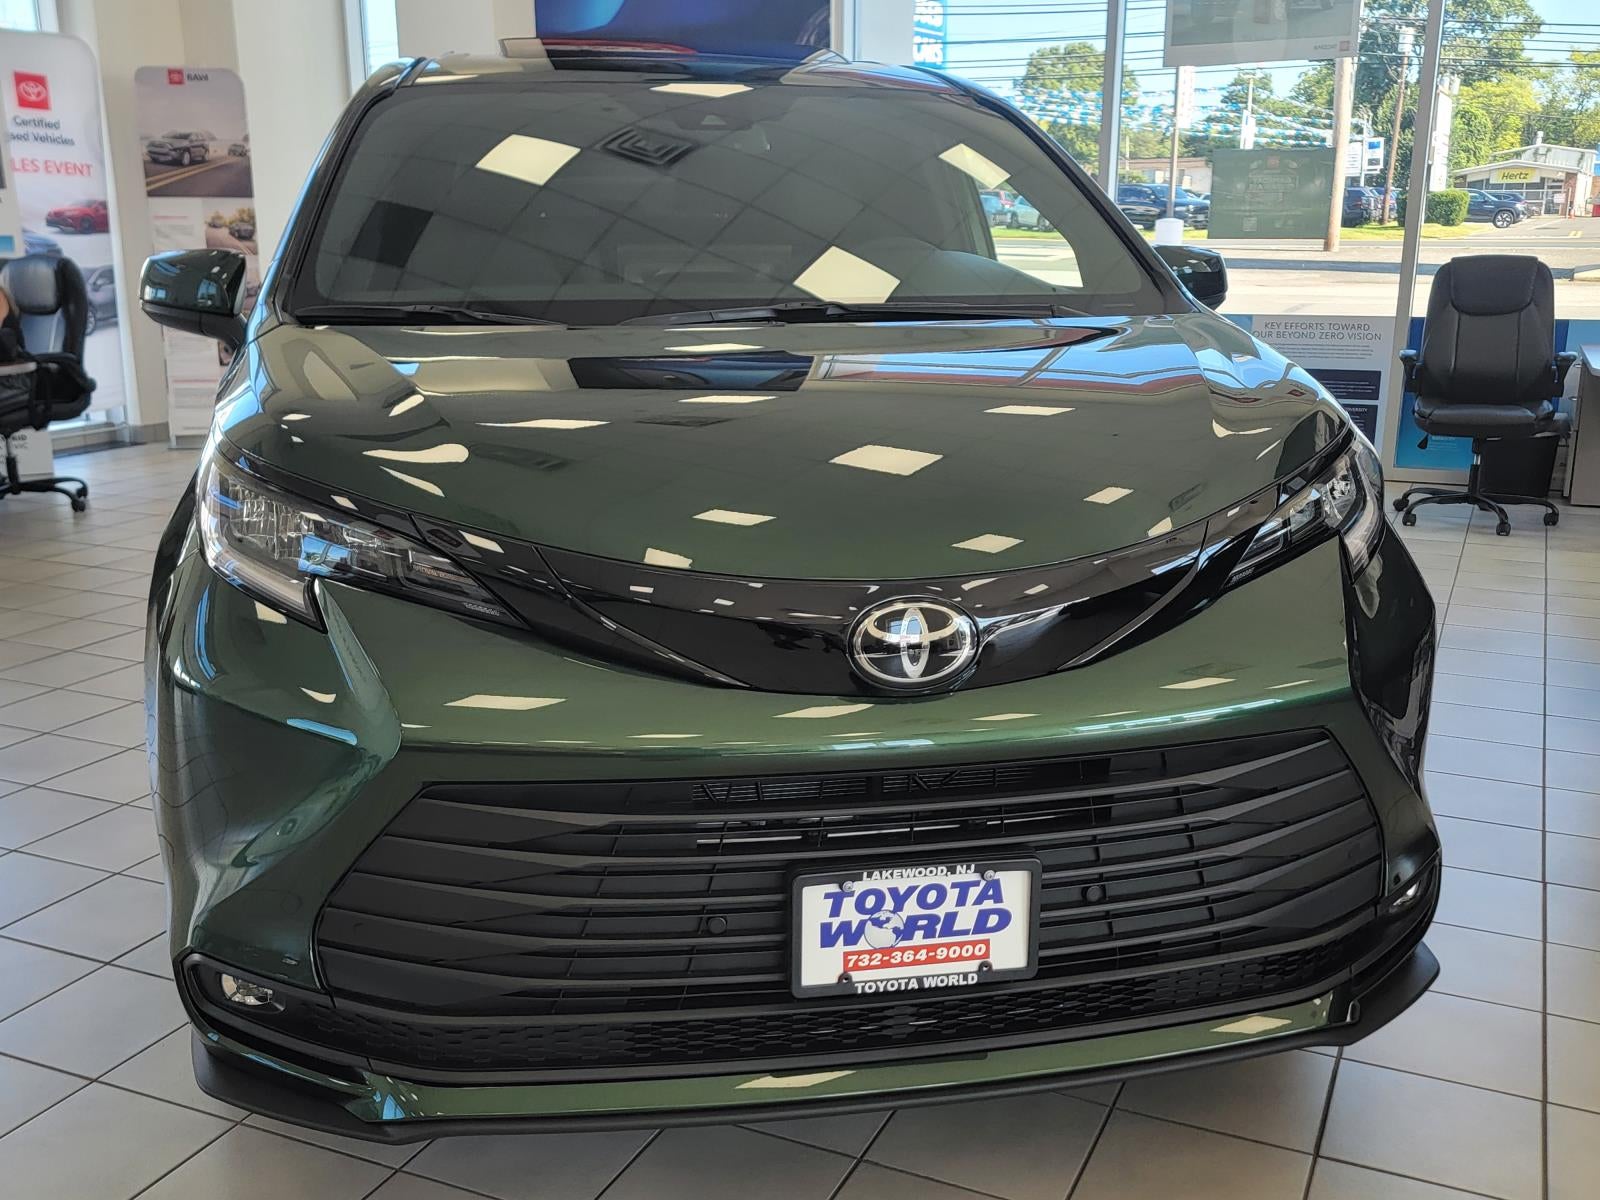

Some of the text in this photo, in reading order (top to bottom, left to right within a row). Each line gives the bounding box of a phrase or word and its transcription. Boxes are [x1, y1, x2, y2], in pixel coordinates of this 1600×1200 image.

[13, 115, 61, 129] Certified
[10, 131, 75, 146] sed Vehicles
[45, 159, 93, 176] EVENT
[1501, 171, 1529, 180] Hertz
[1264, 321, 1371, 331] KEY EFFORTS TOWARD
[1252, 330, 1382, 341] OUR BEYOND ZERO VISION
[862, 863, 975, 882] LAKEWOOD, NJ
[823, 879, 1005, 918] TOYOTA
[847, 943, 987, 968] 732-364-9000
[855, 973, 978, 994] TOYOTA WORLD
